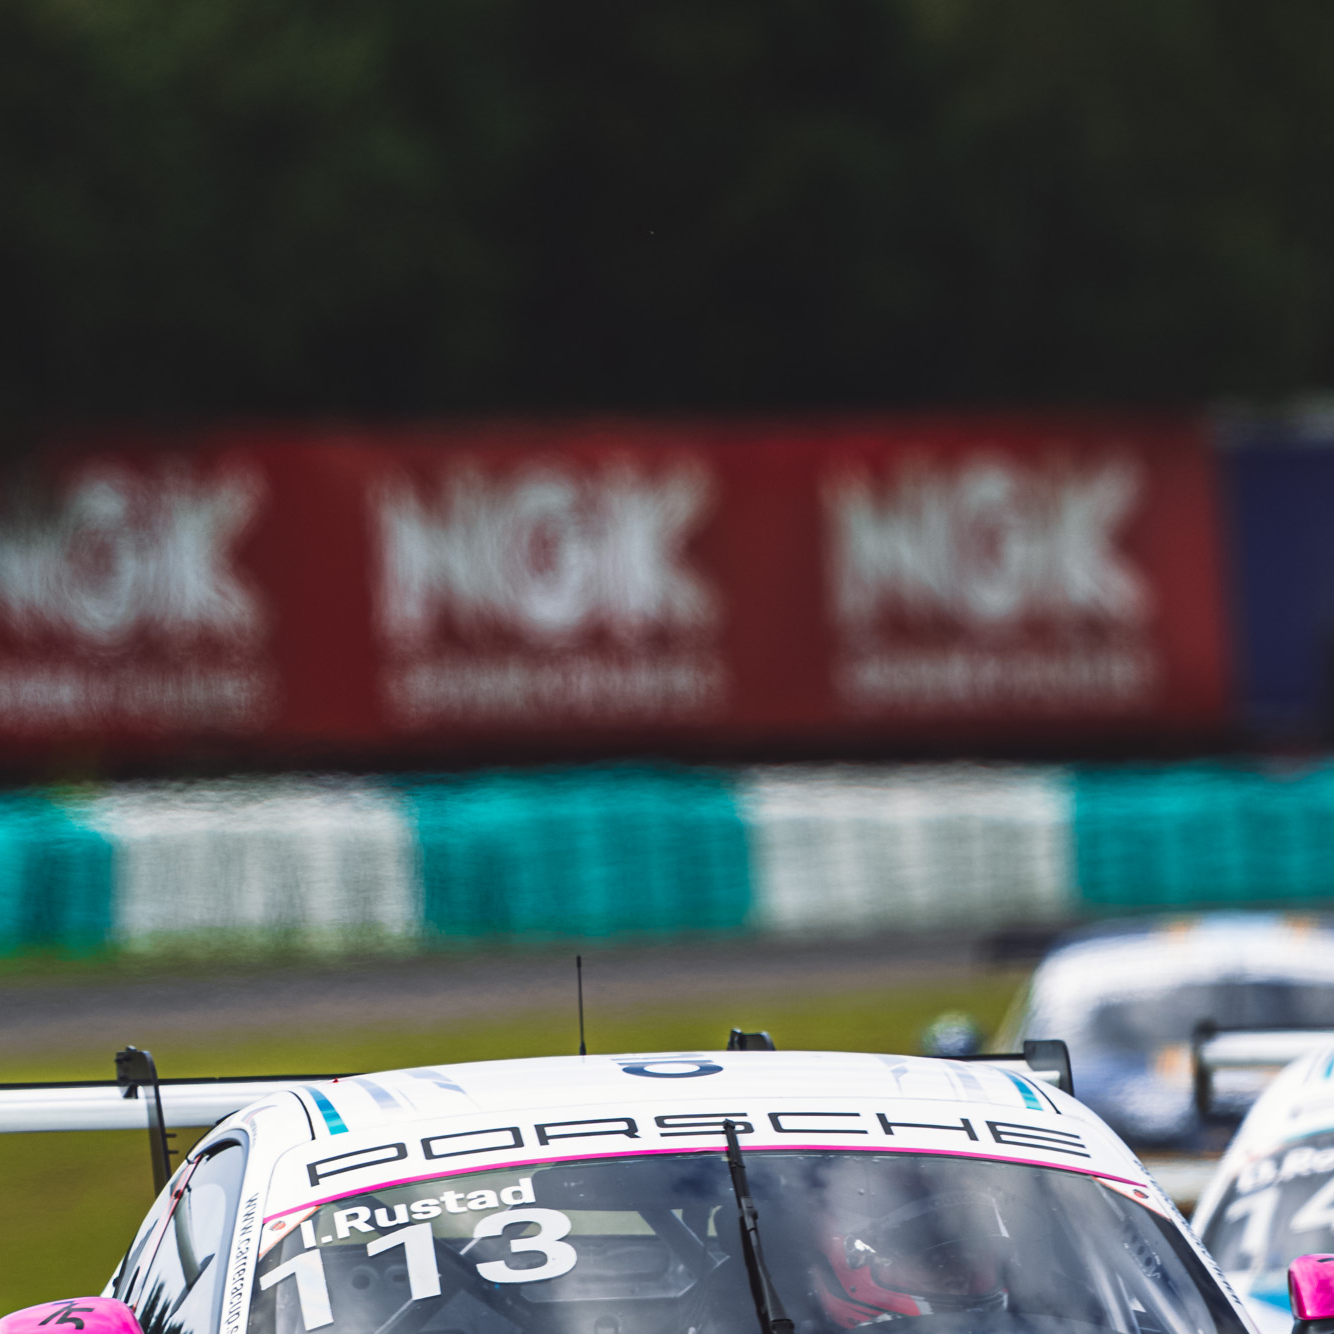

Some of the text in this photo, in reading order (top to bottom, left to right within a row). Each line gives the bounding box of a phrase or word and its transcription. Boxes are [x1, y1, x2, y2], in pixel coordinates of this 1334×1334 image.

[377, 462, 713, 640] NGK
[827, 455, 1147, 626] NGK
[306, 1111, 1092, 1188] PORSCHE
[259, 1207, 578, 1332] 113
